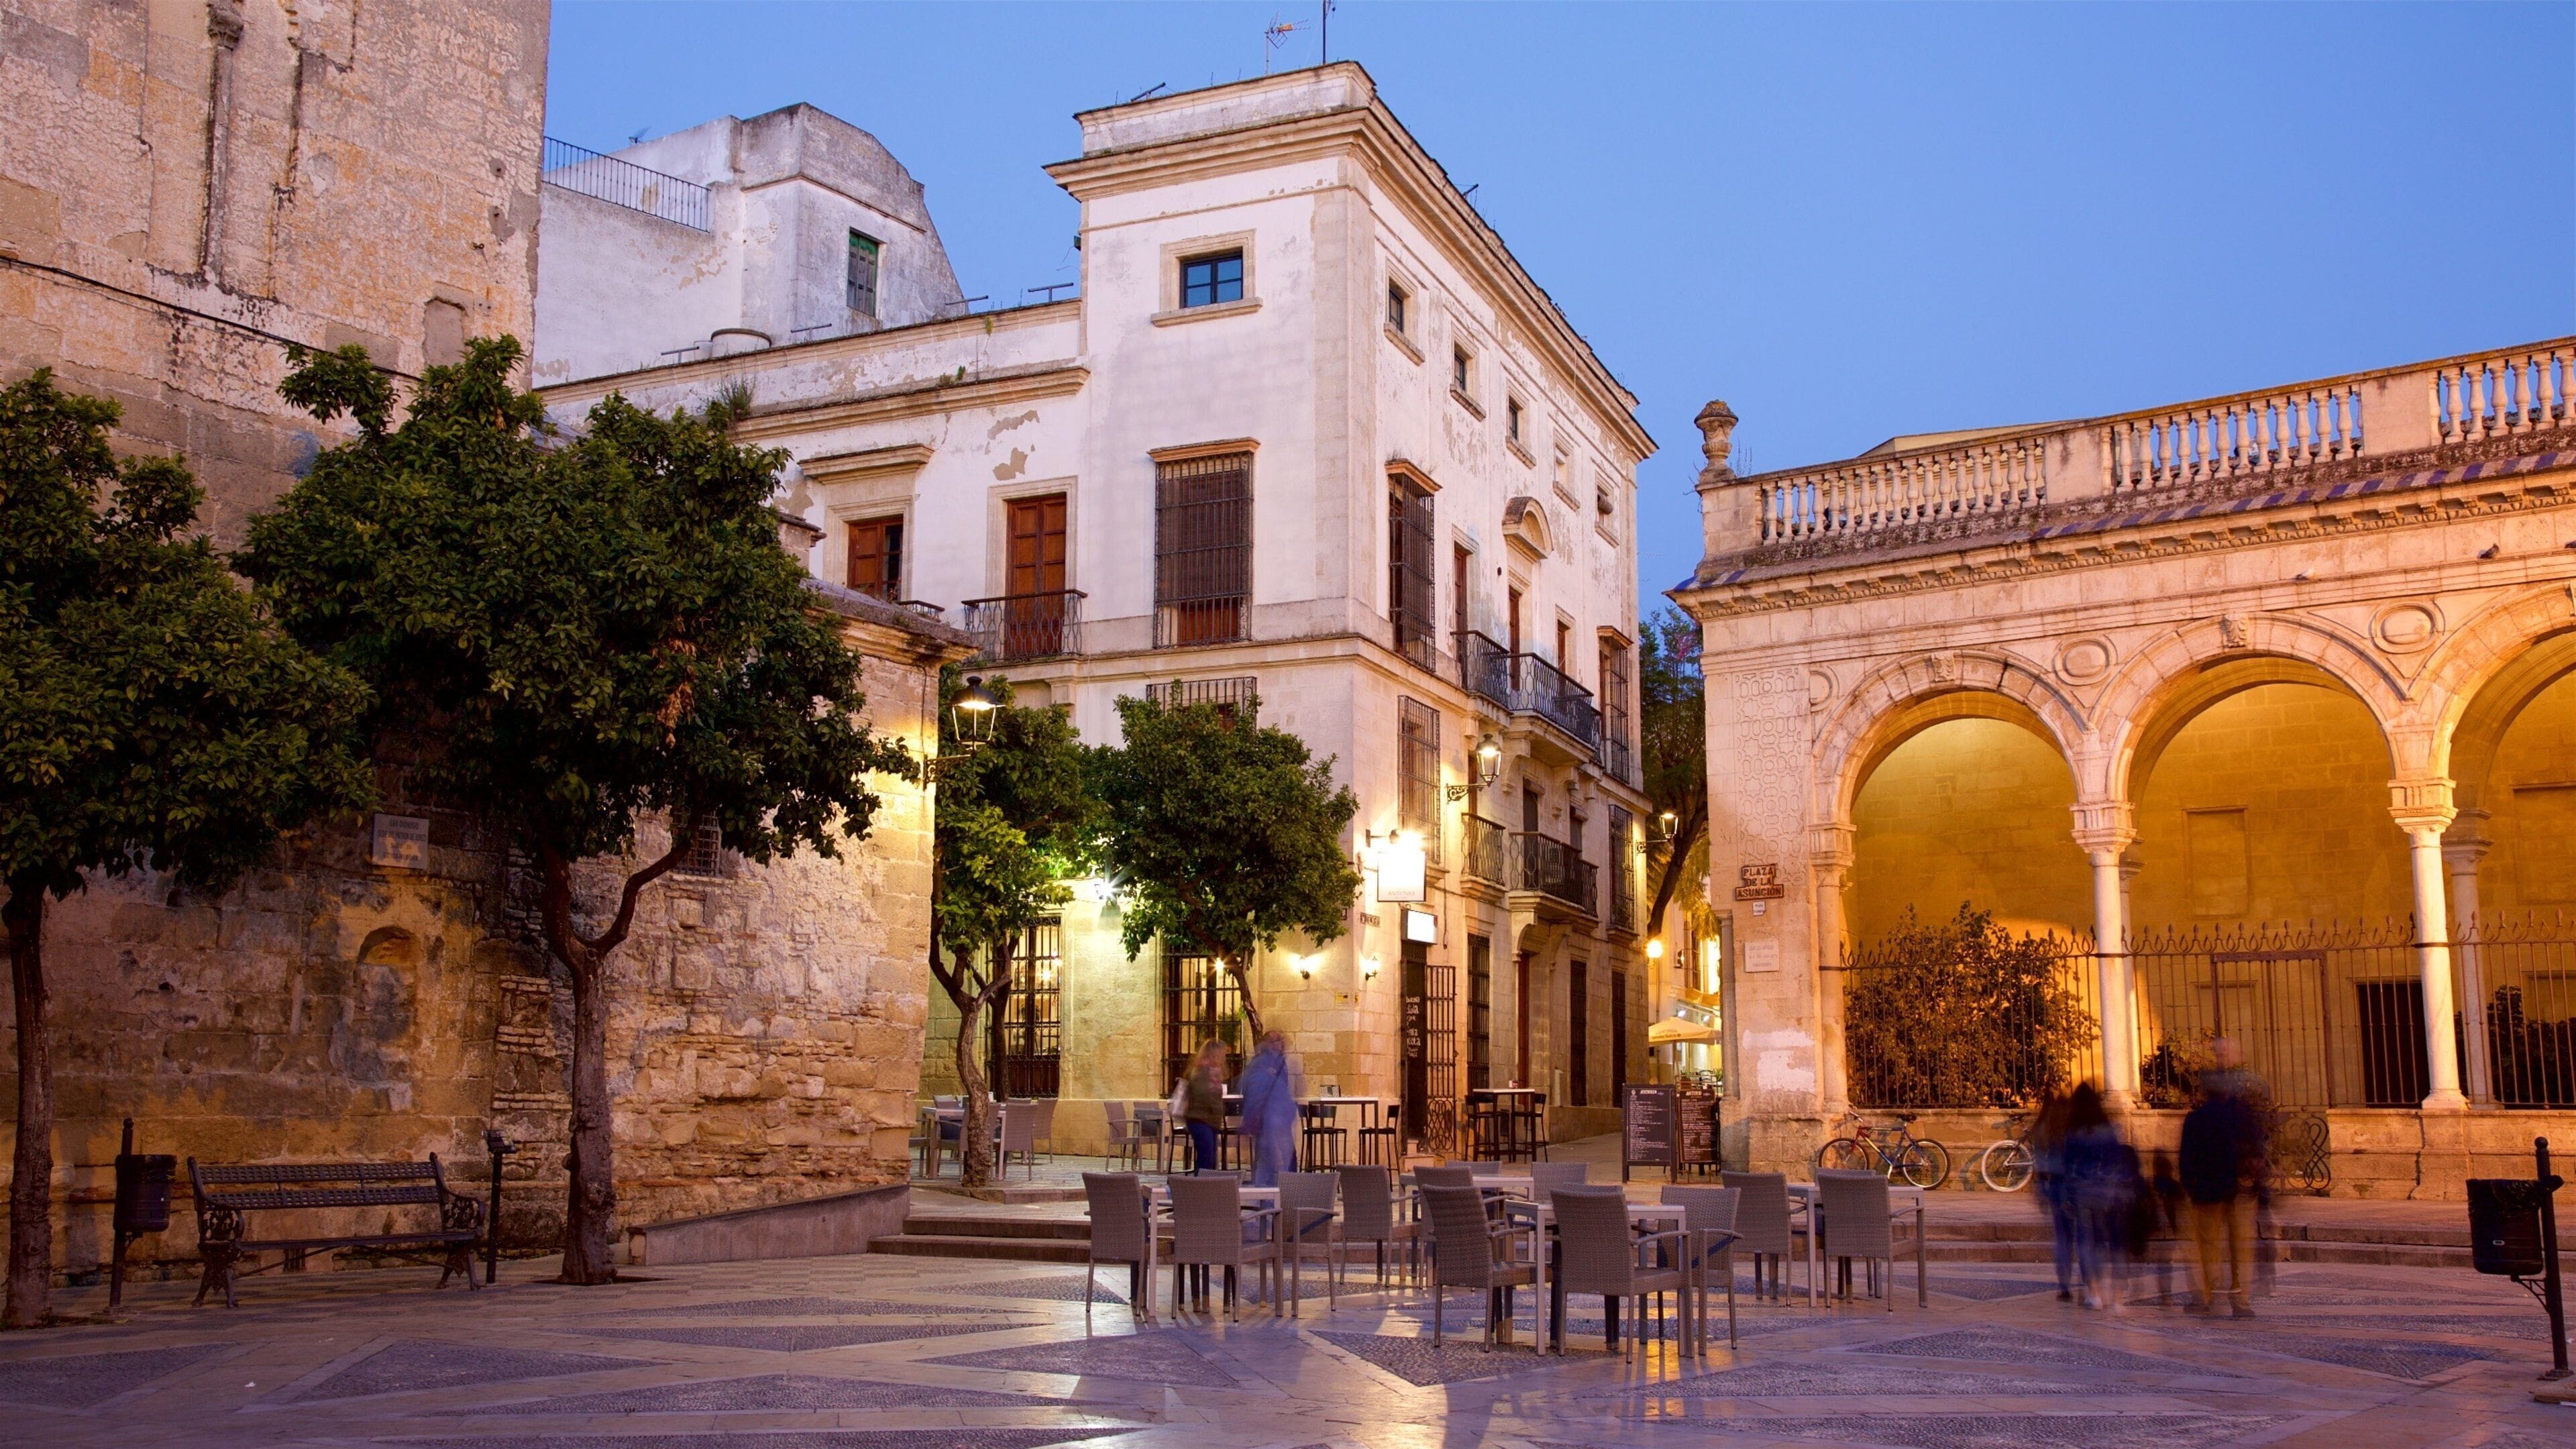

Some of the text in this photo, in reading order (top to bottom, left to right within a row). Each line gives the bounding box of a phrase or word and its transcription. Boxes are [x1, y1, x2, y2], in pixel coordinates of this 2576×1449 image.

[1743, 867, 1773, 876] PLAZA
[1746, 877, 1772, 886] DE LA
